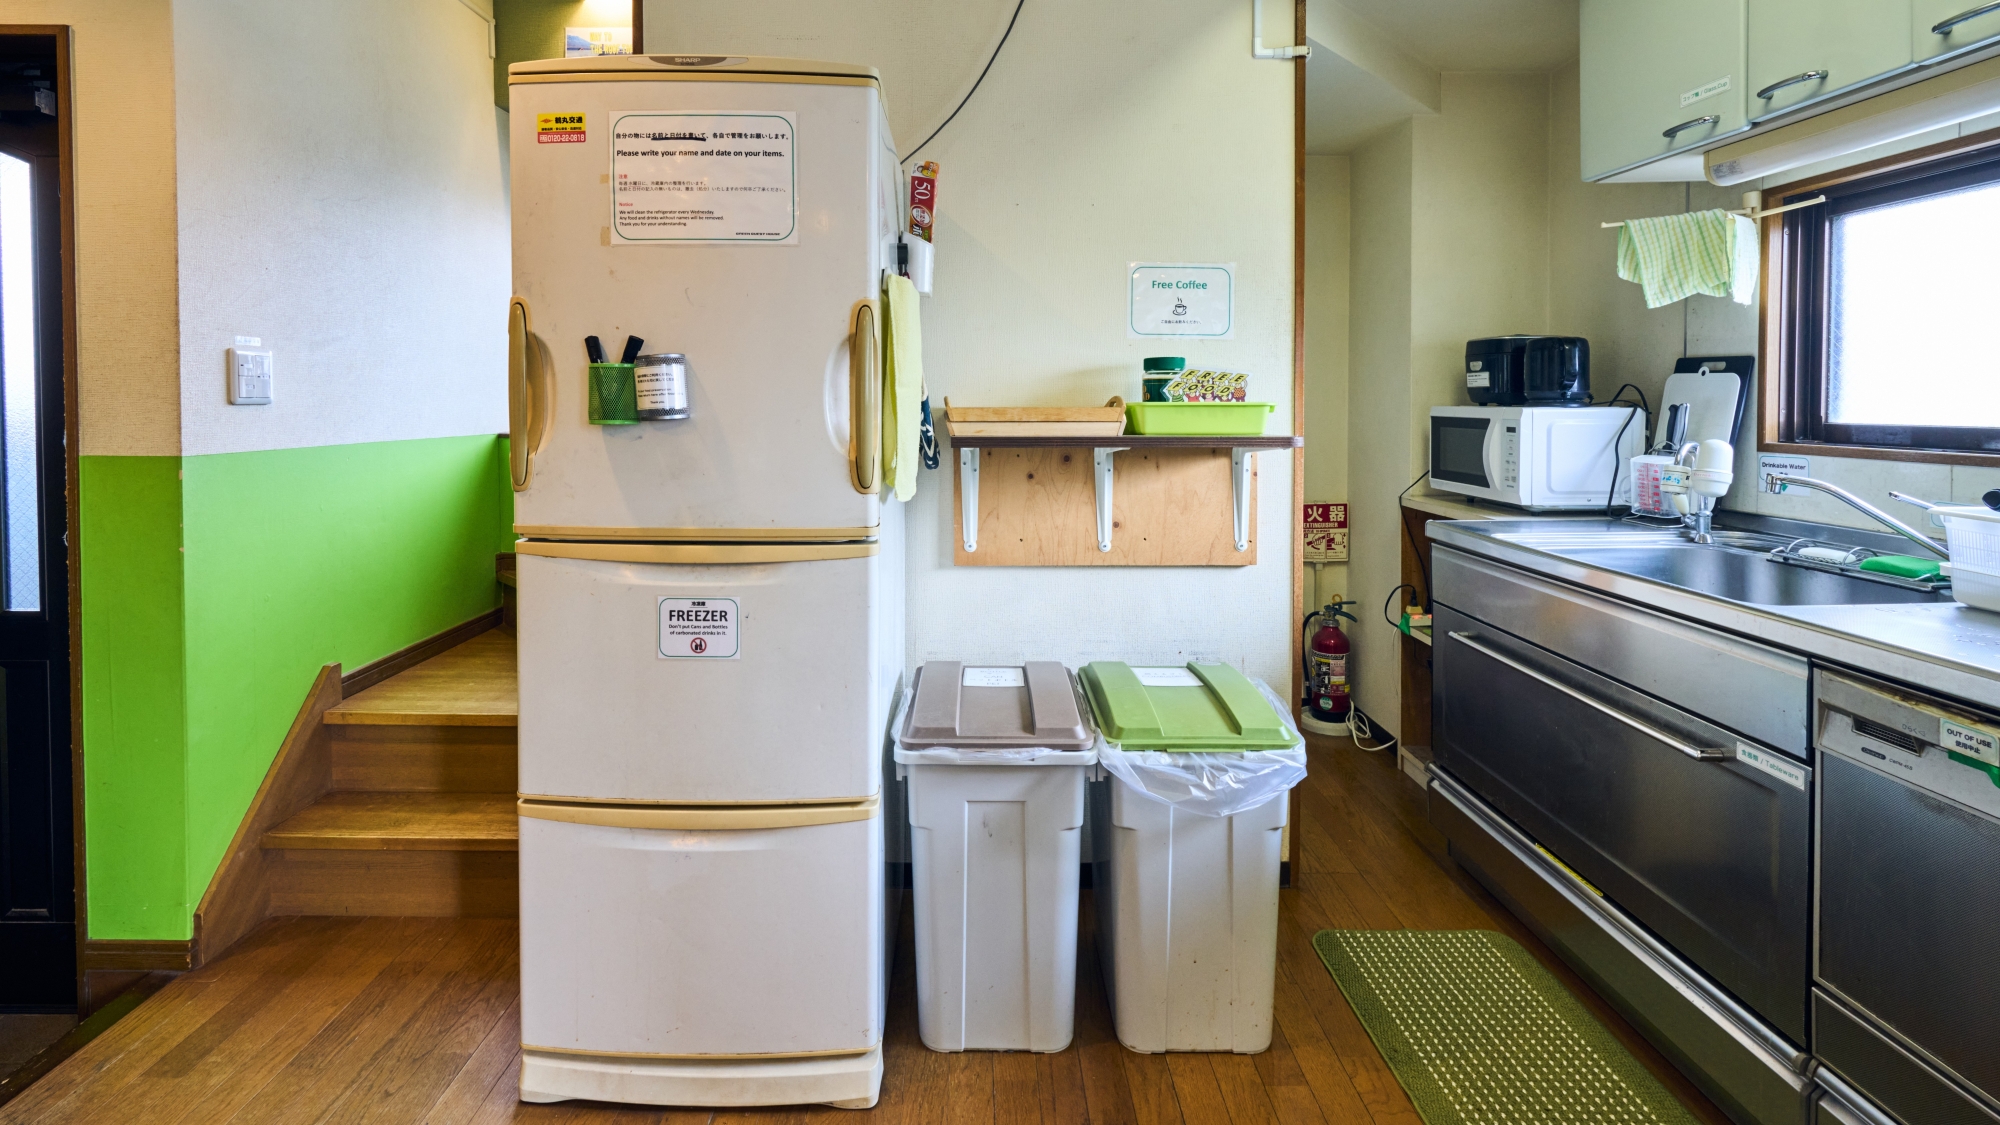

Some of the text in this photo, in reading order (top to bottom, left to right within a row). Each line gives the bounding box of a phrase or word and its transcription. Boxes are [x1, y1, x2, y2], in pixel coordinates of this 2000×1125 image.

[1152, 280, 1208, 290] Free Coffee
[1185, 370, 1244, 382] FREE
[1172, 382, 1231, 394] FOOD
[669, 610, 728, 622] FREEZER
[1947, 728, 1992, 749] OUT OF USE
[1765, 760, 1799, 781] Tableware
